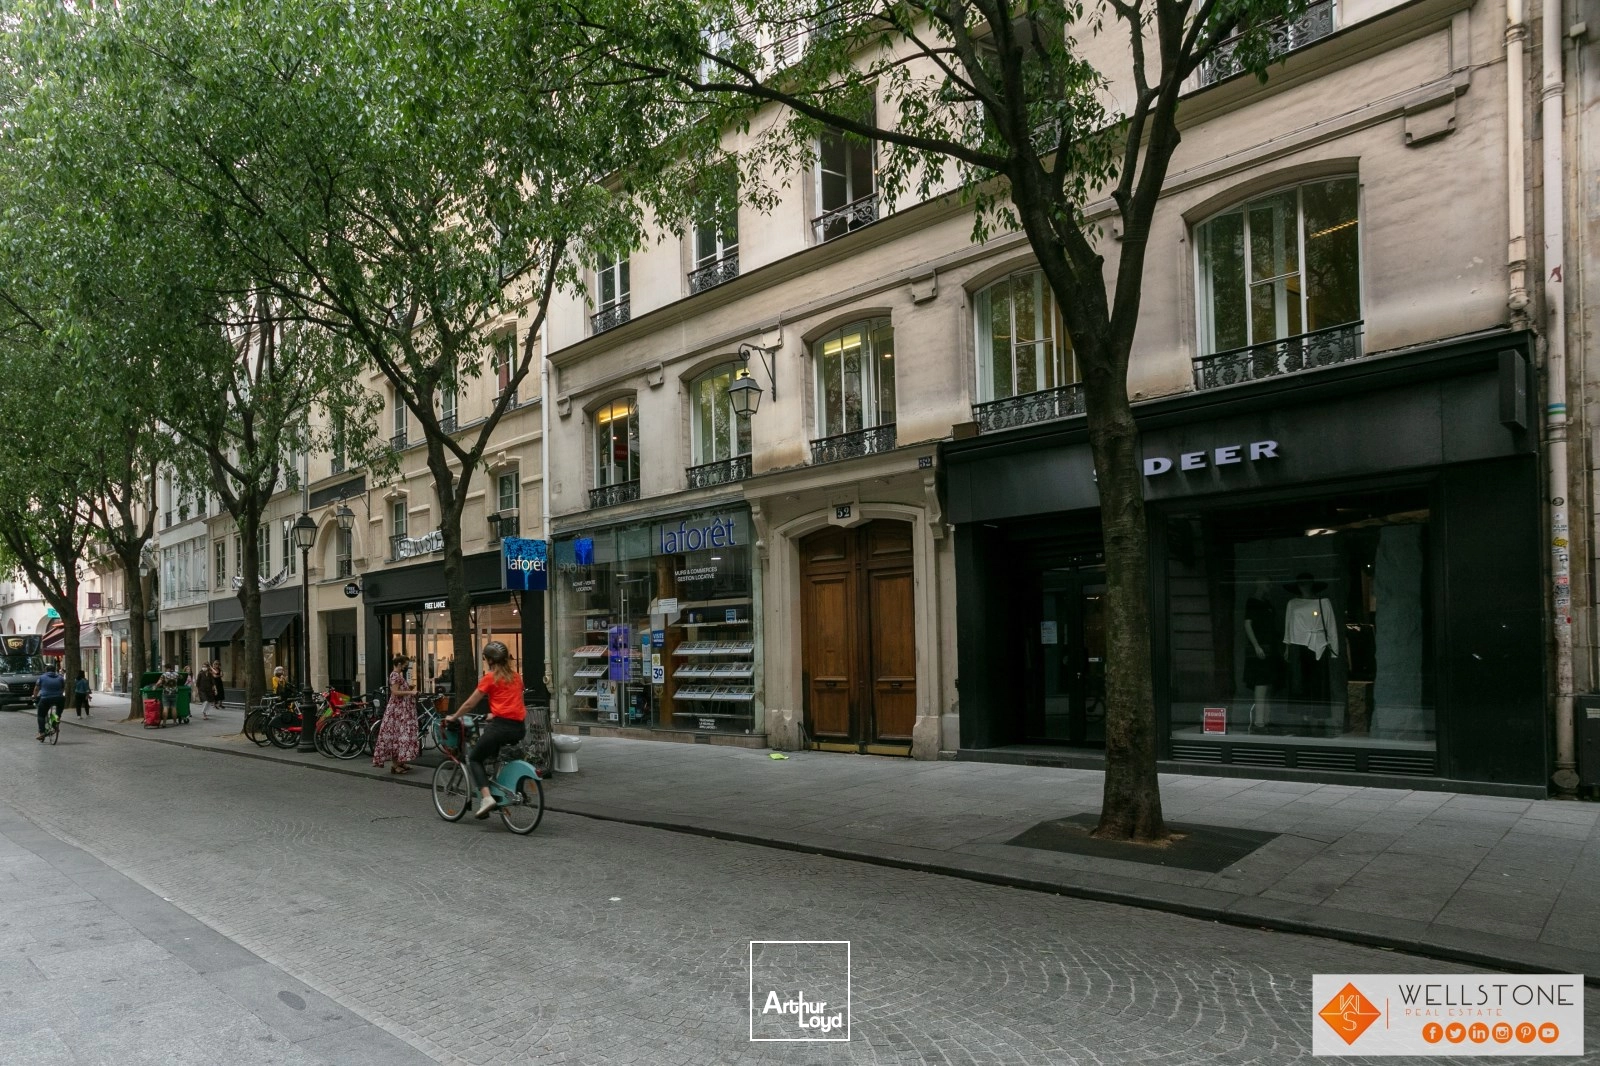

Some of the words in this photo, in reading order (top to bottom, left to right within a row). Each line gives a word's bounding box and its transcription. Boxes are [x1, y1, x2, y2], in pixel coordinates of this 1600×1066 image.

[919, 458, 931, 467] 52
[837, 507, 850, 518] 52
[660, 516, 737, 554] laforêt
[507, 554, 546, 572] laforêt
[690, 566, 718, 574] COMMERCES
[434, 600, 446, 608] LANCE
[653, 668, 663, 679] 30
